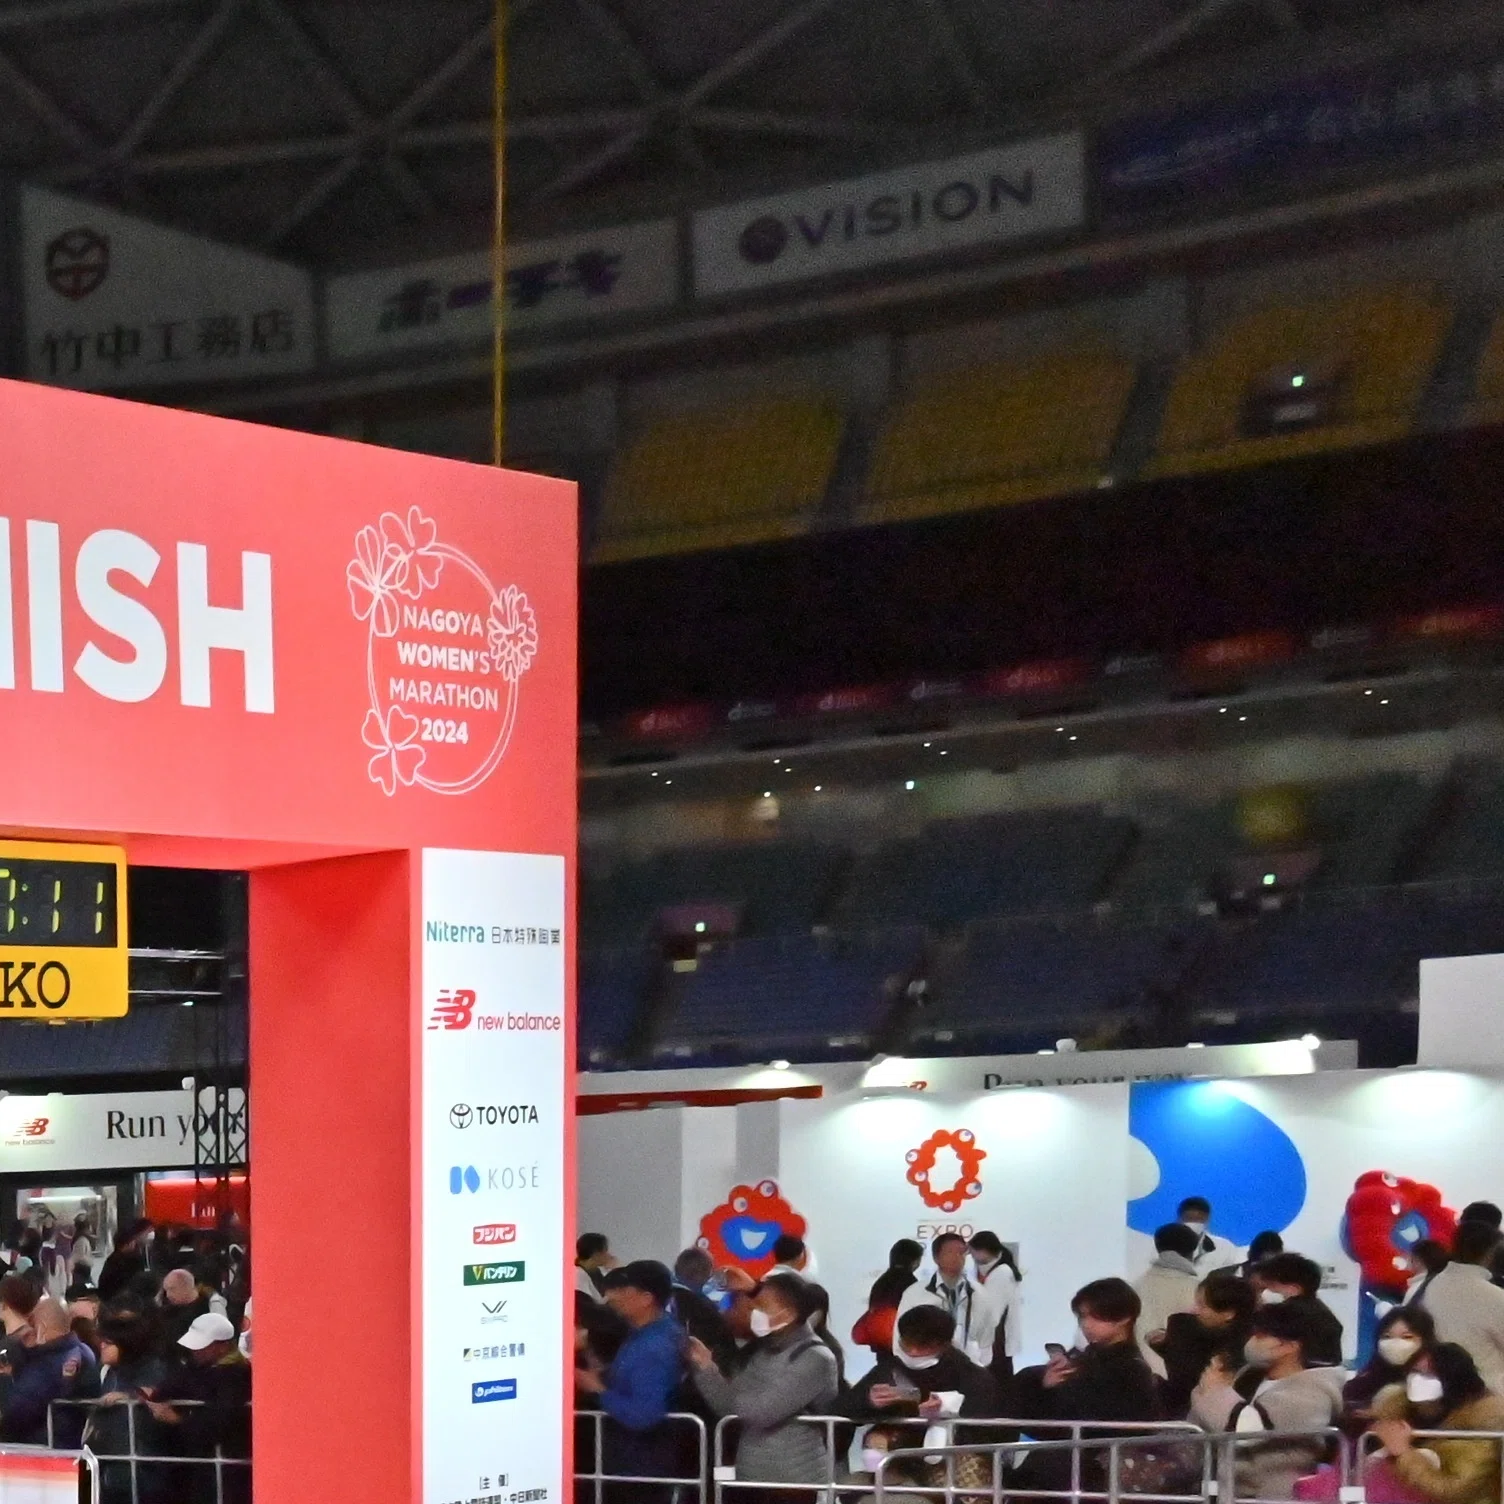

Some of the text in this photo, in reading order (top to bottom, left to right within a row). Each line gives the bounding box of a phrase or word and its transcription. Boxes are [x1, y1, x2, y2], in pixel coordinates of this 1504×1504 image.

[794, 171, 1035, 249] VISION
[39, 309, 297, 376] 竹中工務店
[403, 606, 484, 637] NAGOYA
[397, 641, 491, 676] WOMEN'S
[389, 678, 499, 711] MARATHON
[421, 718, 469, 744] 2024
[426, 920, 485, 944] Niterra
[477, 1015, 504, 1031] new
[507, 1011, 561, 1031] balance
[106, 1110, 166, 1139] Run
[476, 1105, 539, 1125] TOYOTA
[488, 1161, 540, 1190] KOSÉ
